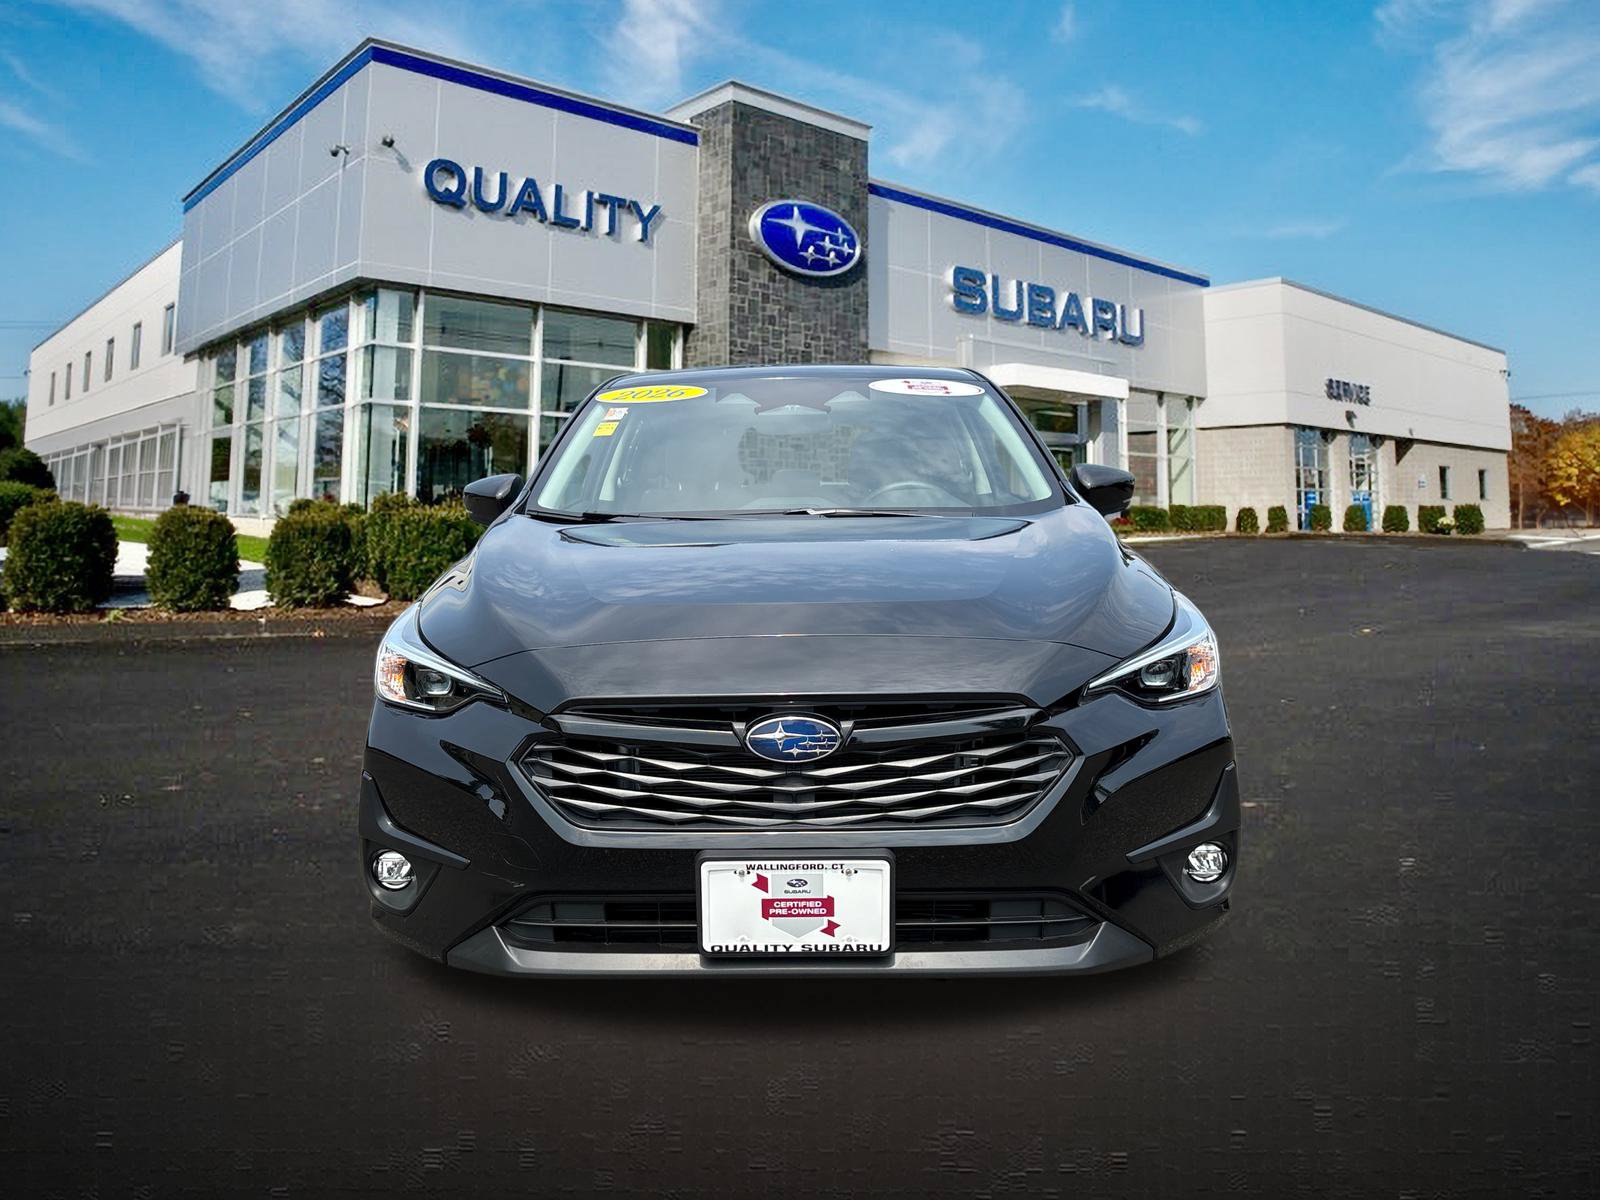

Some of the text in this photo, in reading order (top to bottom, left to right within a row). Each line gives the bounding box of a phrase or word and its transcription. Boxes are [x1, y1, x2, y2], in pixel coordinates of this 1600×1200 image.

[424, 158, 661, 243] QUALITY
[949, 265, 1145, 346] SUBARU
[612, 388, 685, 401] 2026
[710, 943, 882, 953] QUALITY SUBARU
